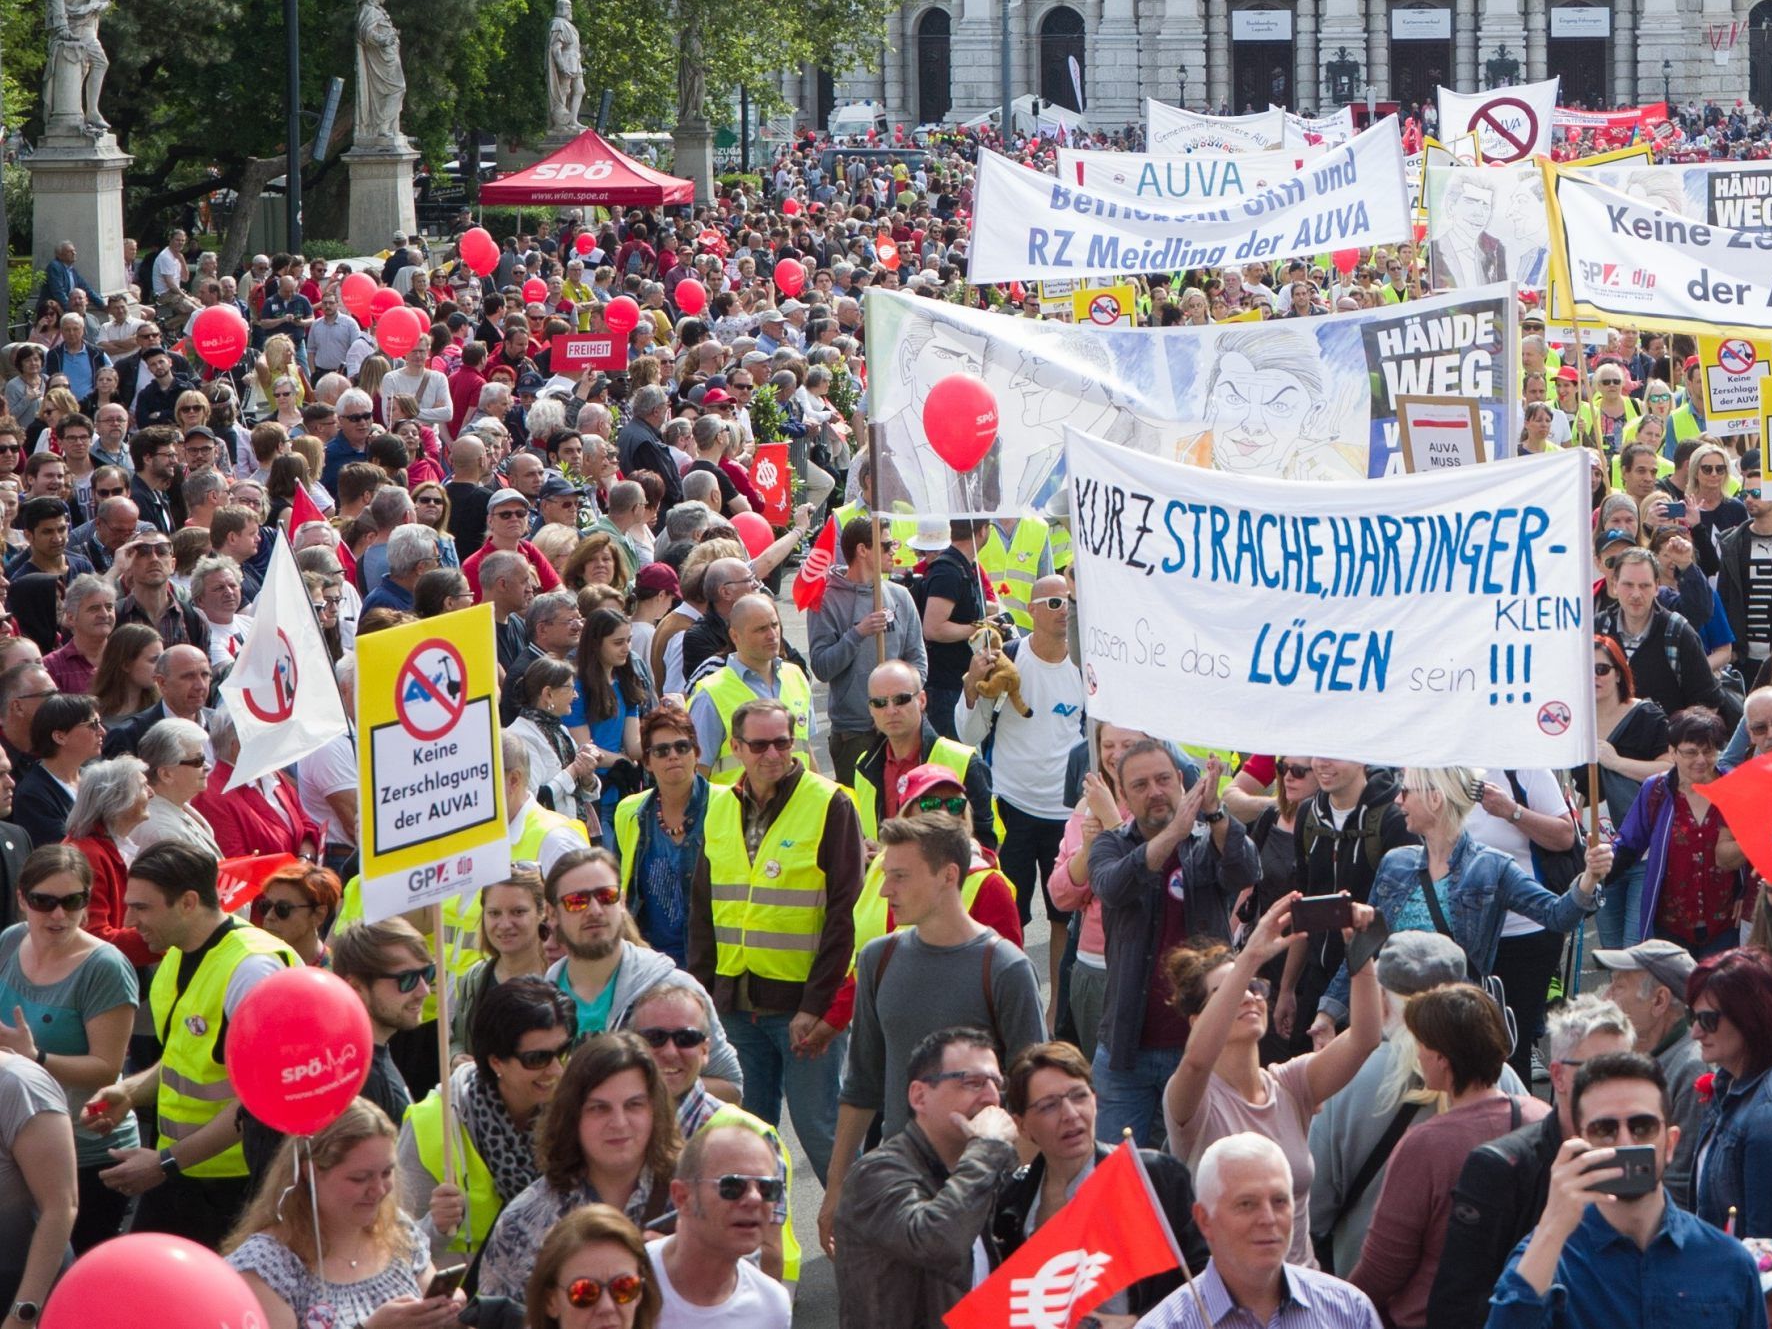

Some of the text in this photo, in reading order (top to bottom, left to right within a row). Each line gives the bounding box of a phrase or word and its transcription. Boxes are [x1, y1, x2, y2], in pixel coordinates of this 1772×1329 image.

[1154, 121, 1204, 143] Gemeinsam
[529, 161, 613, 180] SPÖ
[1137, 161, 1244, 197] AUVA
[1314, 146, 1357, 194] und
[531, 191, 609, 201] www.wien.spoe.at
[1028, 200, 1370, 271] RZ Meidling der AUVA
[1606, 204, 1711, 247] Keine
[1632, 268, 1656, 288] djp
[1687, 269, 1751, 305] der
[1377, 311, 1495, 357] HÄNDE
[569, 342, 611, 356] FREIHEIT
[1382, 349, 1493, 410] WEG
[1712, 386, 1758, 395] Zerschlagu
[1719, 397, 1734, 406] der
[1429, 442, 1459, 453] AUVA
[1430, 457, 1461, 467] MUSS
[1495, 596, 1582, 631] KLEIN
[1134, 617, 1166, 669] Sie
[1180, 646, 1231, 680] das
[1247, 618, 1394, 694] LÜGEN
[1409, 659, 1476, 692] sein
[413, 742, 459, 766] Keine
[381, 761, 490, 805] Zerschlagung
[394, 794, 479, 830] der AUVA!
[456, 856, 473, 876] djp
[281, 1057, 322, 1084] SPÖ
